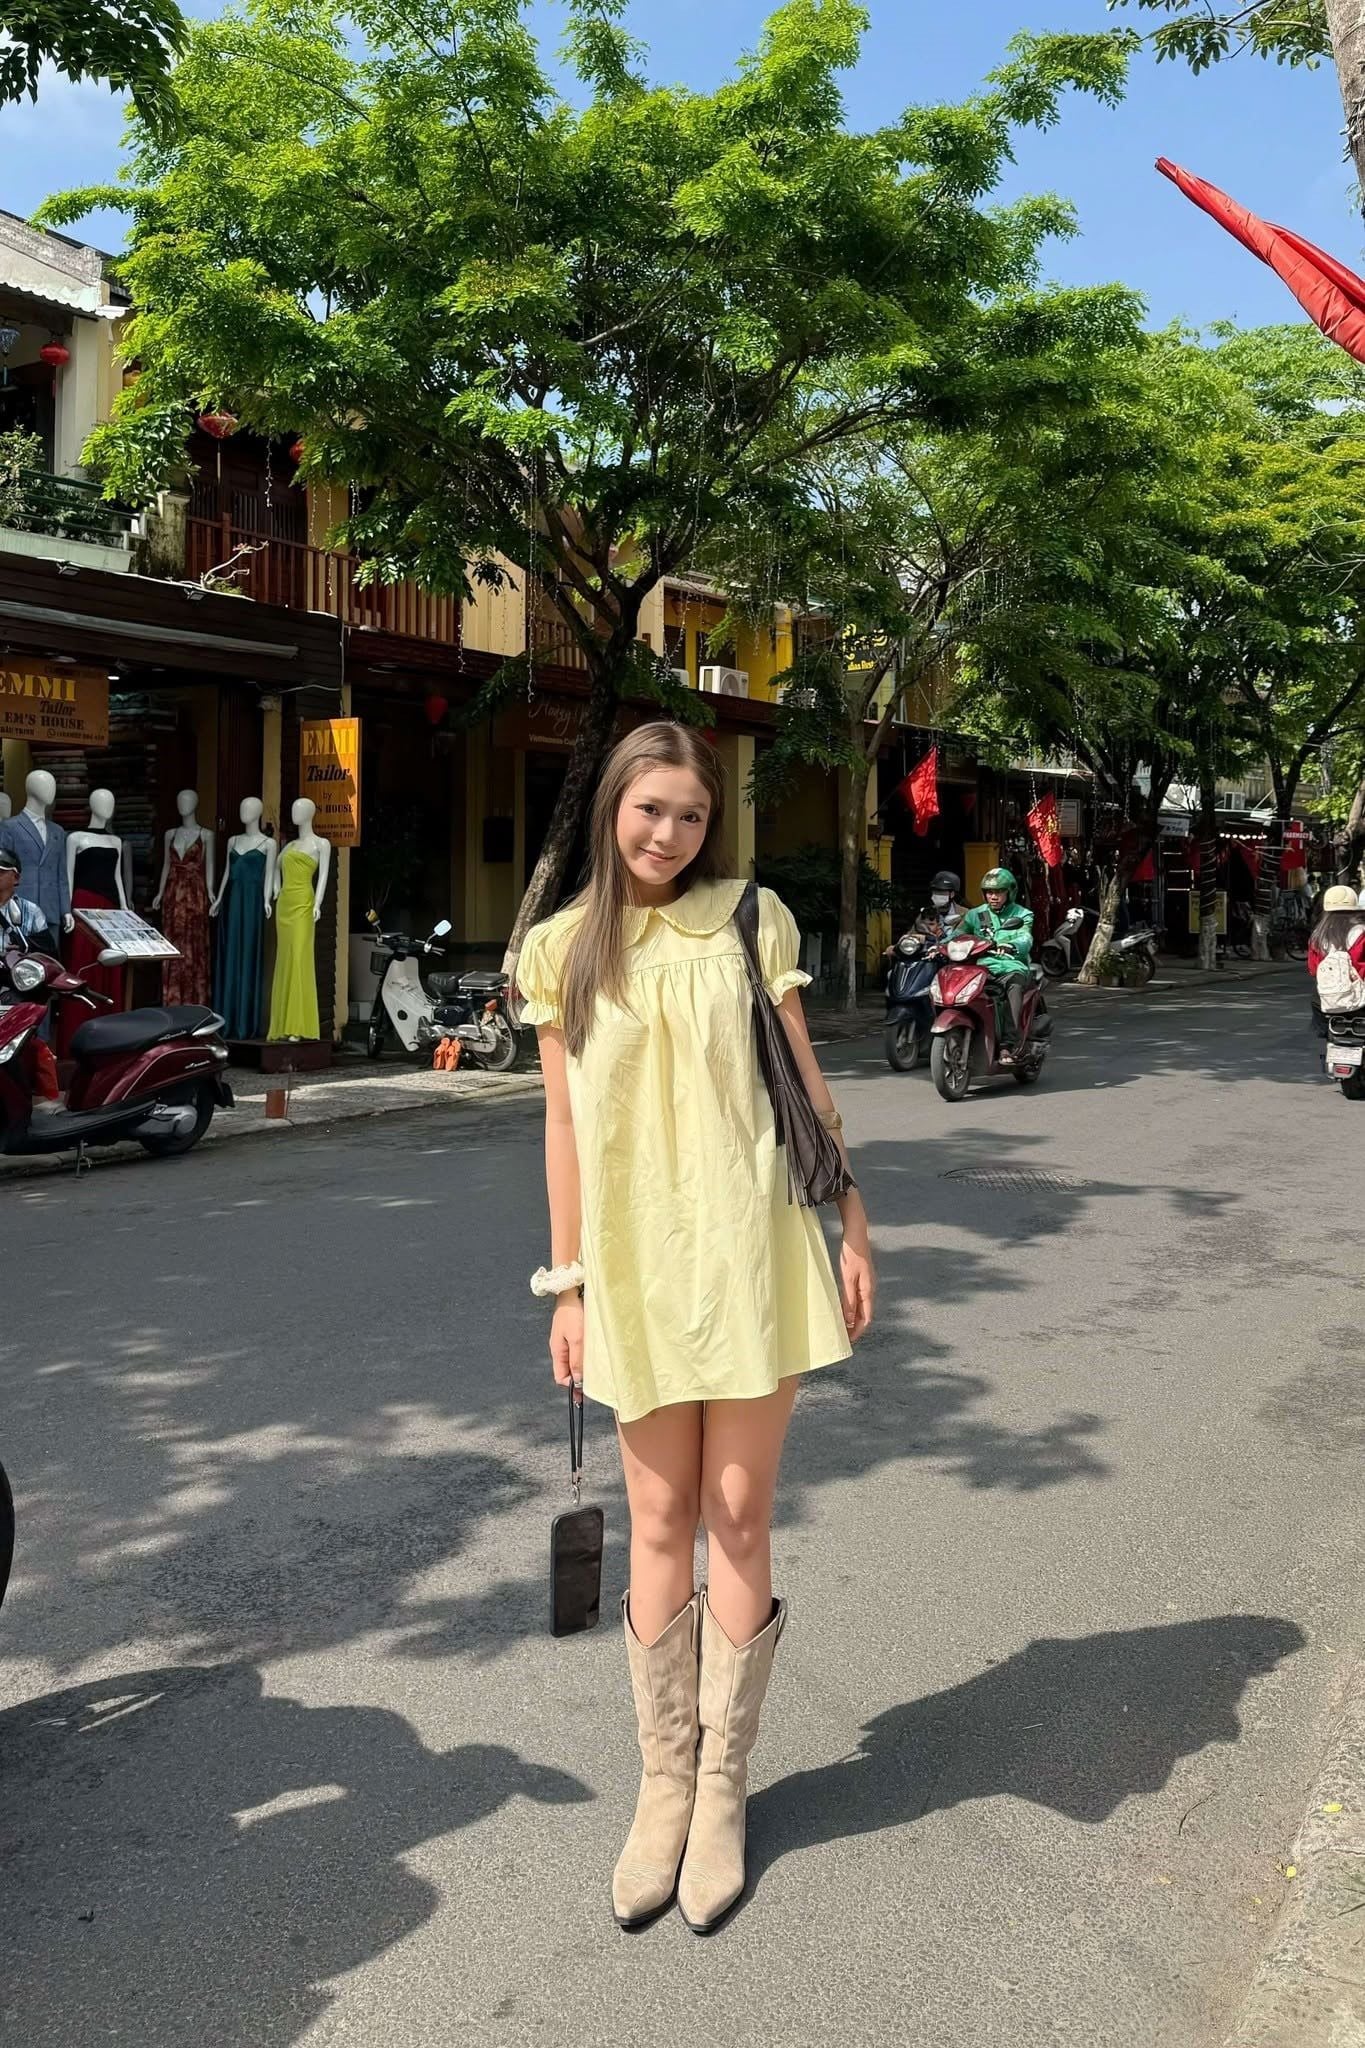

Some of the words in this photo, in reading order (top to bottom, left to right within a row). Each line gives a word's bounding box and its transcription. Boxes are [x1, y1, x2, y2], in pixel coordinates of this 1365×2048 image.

[41, 715, 85, 731] HOUSE
[303, 728, 356, 756] EMMI
[307, 764, 352, 781] Tailor
[326, 804, 353, 813] HOUSE
